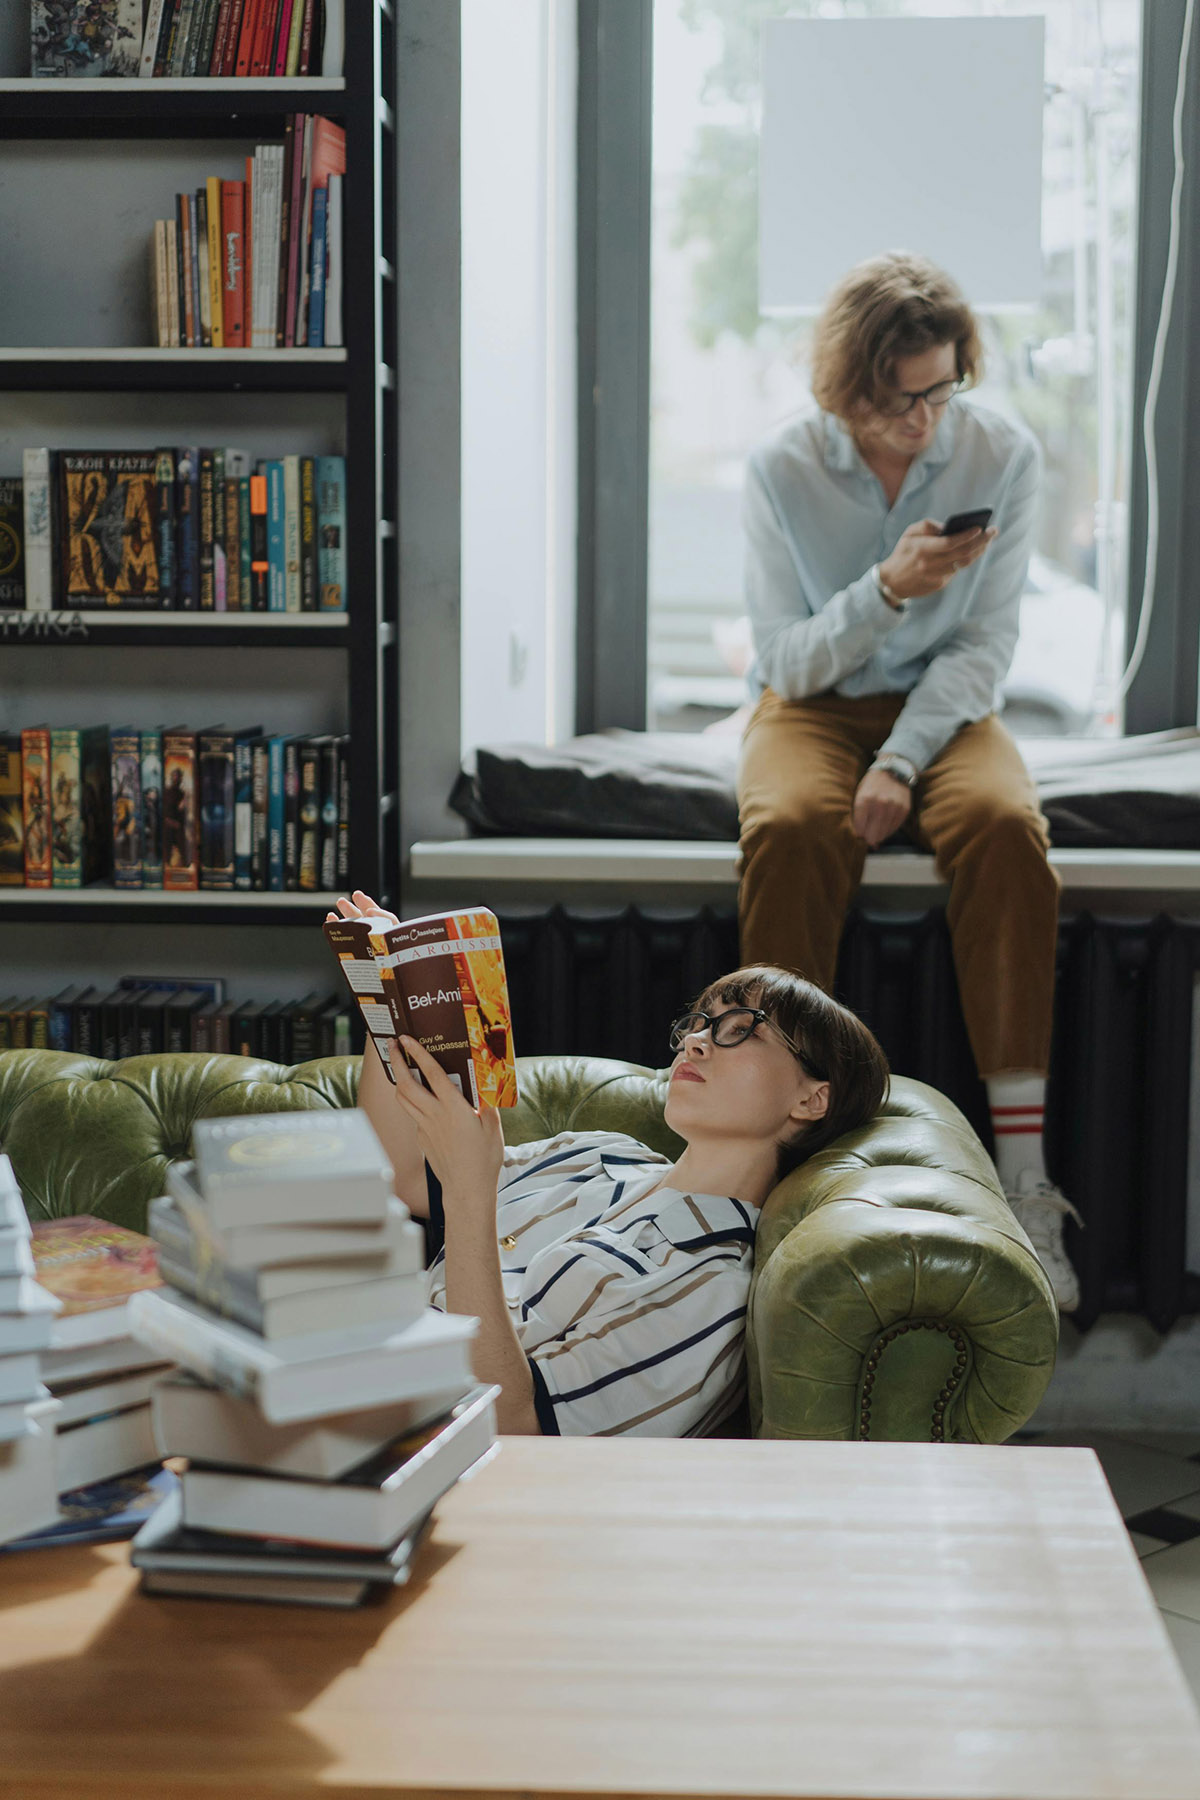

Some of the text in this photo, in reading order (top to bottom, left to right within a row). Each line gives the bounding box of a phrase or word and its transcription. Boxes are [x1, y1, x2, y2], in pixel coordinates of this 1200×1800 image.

[392, 928, 445, 943] Petits Classiques
[395, 937, 498, 963] LAROUSSE
[407, 987, 462, 1010] Bel-Ami
[419, 1036, 434, 1045] Guy
